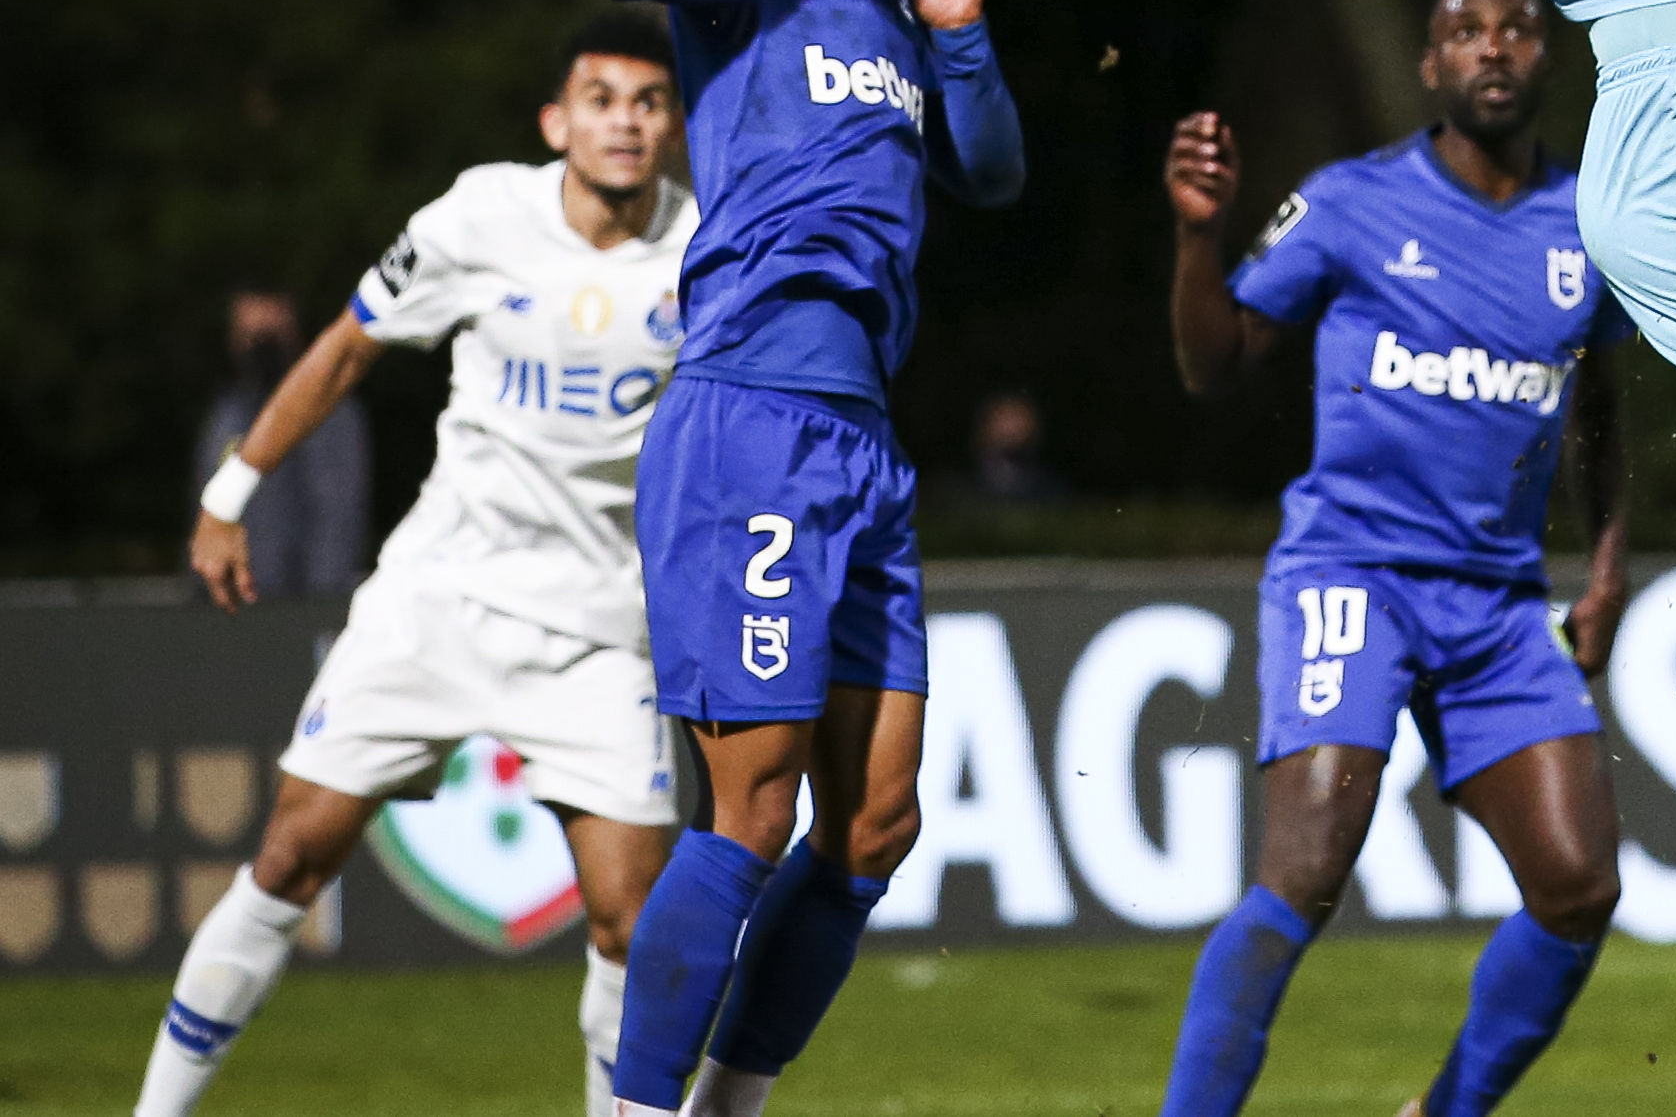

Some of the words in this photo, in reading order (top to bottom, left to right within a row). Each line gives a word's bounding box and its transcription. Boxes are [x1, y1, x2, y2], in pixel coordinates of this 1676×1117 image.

[498, 357, 660, 417] MEO
[1369, 329, 1576, 416] betway
[744, 512, 795, 600] 2
[1296, 585, 1369, 662] 10
